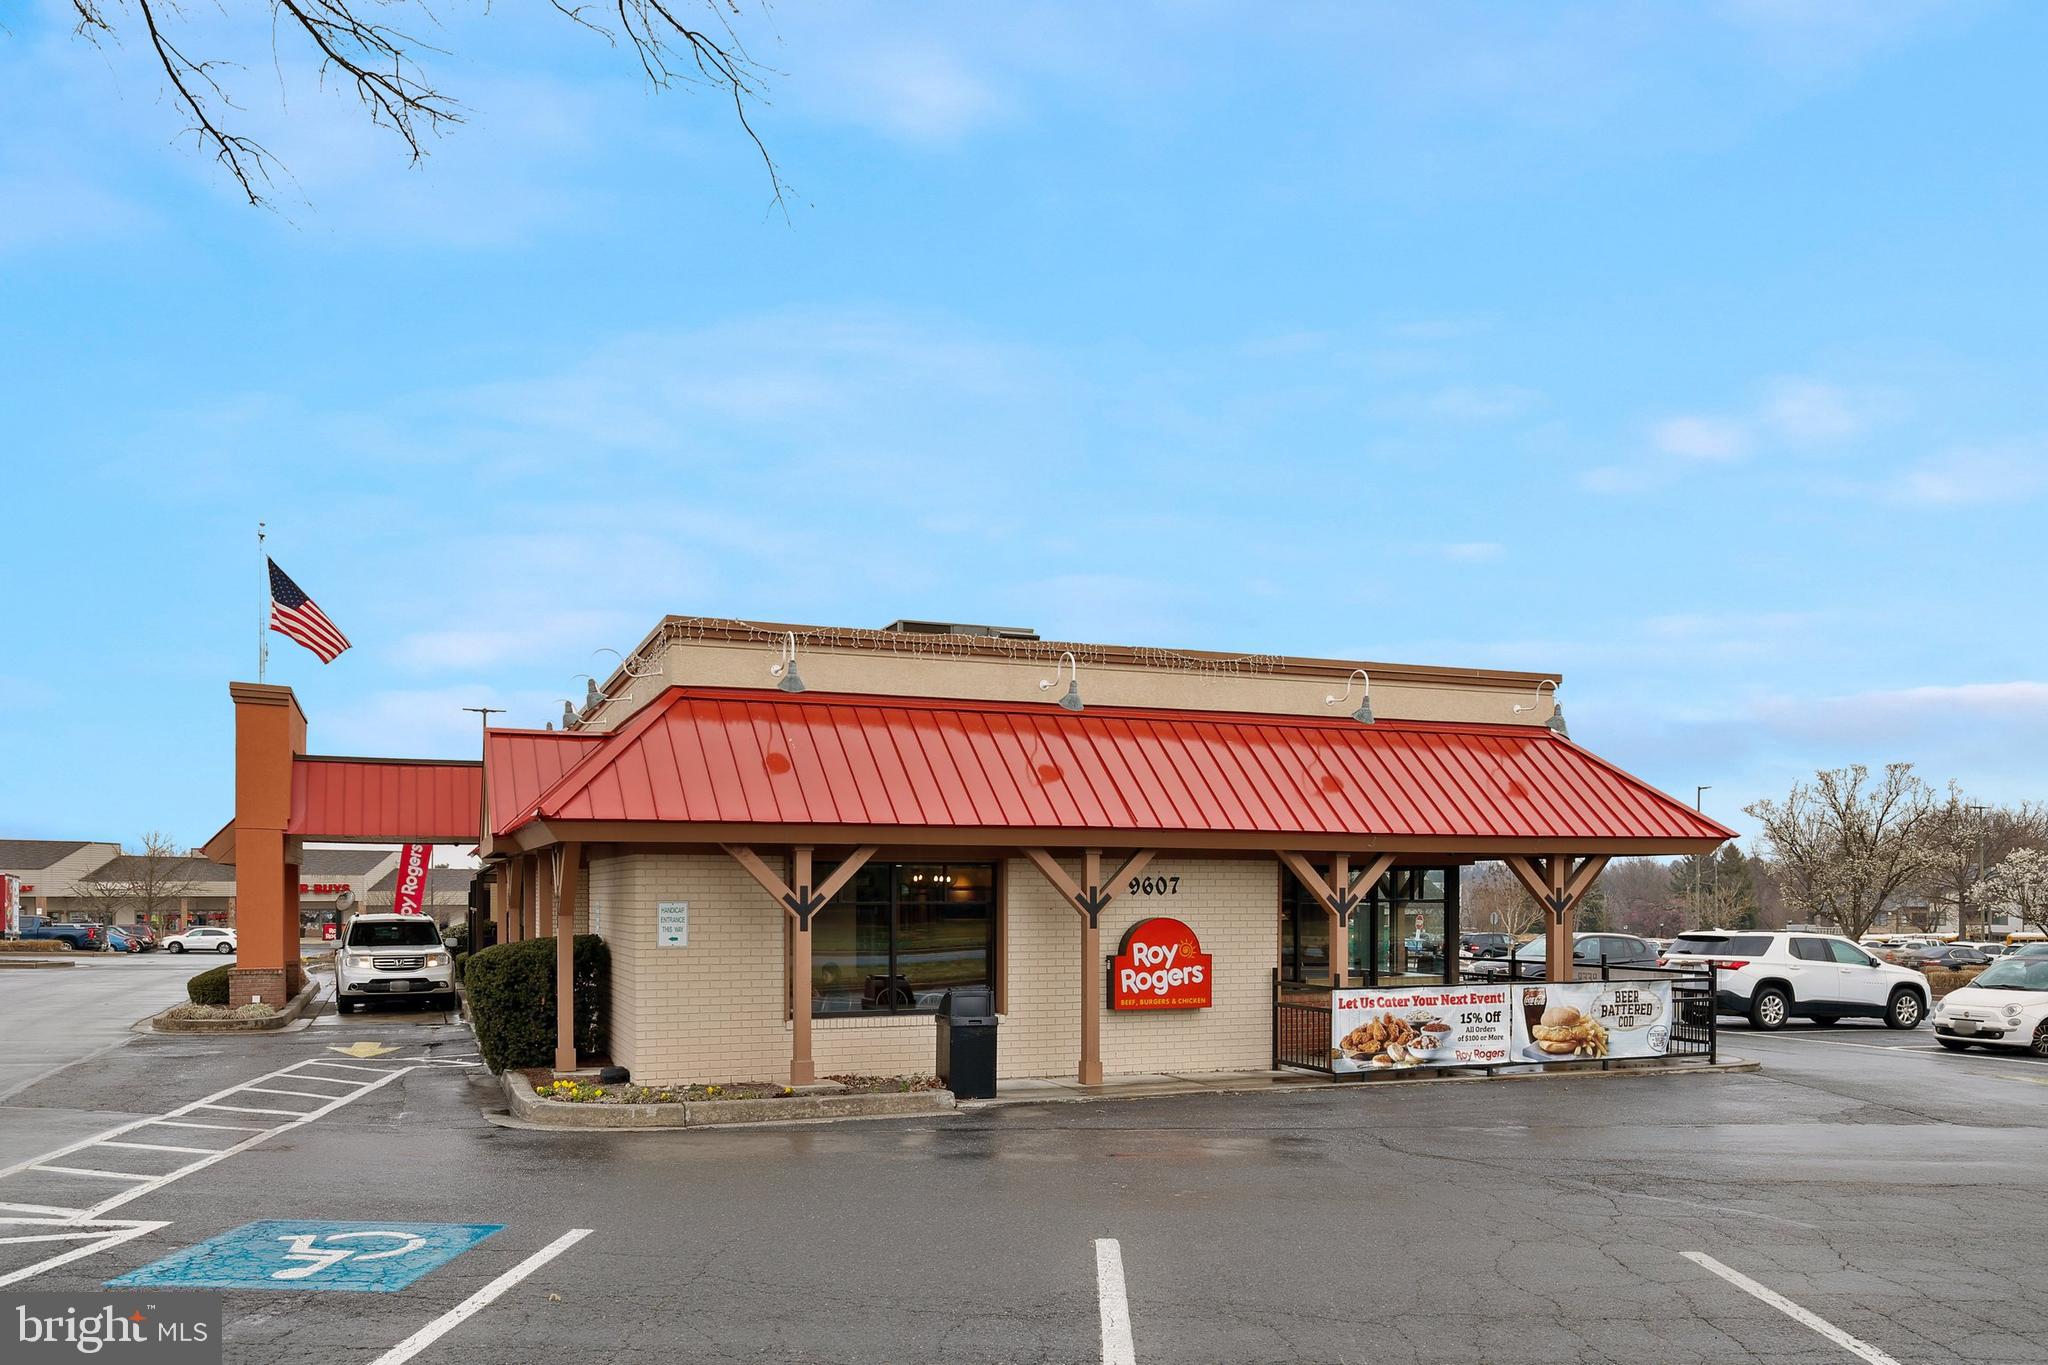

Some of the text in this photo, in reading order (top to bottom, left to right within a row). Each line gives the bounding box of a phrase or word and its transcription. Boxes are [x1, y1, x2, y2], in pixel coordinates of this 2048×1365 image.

[401, 844, 424, 895] Rogers
[314, 883, 351, 894] BUYS
[1128, 876, 1180, 896] 9607
[1132, 942, 1178, 969] Roy
[1120, 965, 1204, 995] Rogers
[1338, 992, 1505, 1010] Let Us Cater Your Next Event!
[1615, 990, 1639, 1003] BEER
[1460, 1011, 1502, 1024] 15% Off
[1601, 1003, 1653, 1018] BATTERED
[1618, 1016, 1635, 1027] COD
[1465, 1034, 1480, 1042] $100
[1455, 1049, 1505, 1062] Roy Rogers
